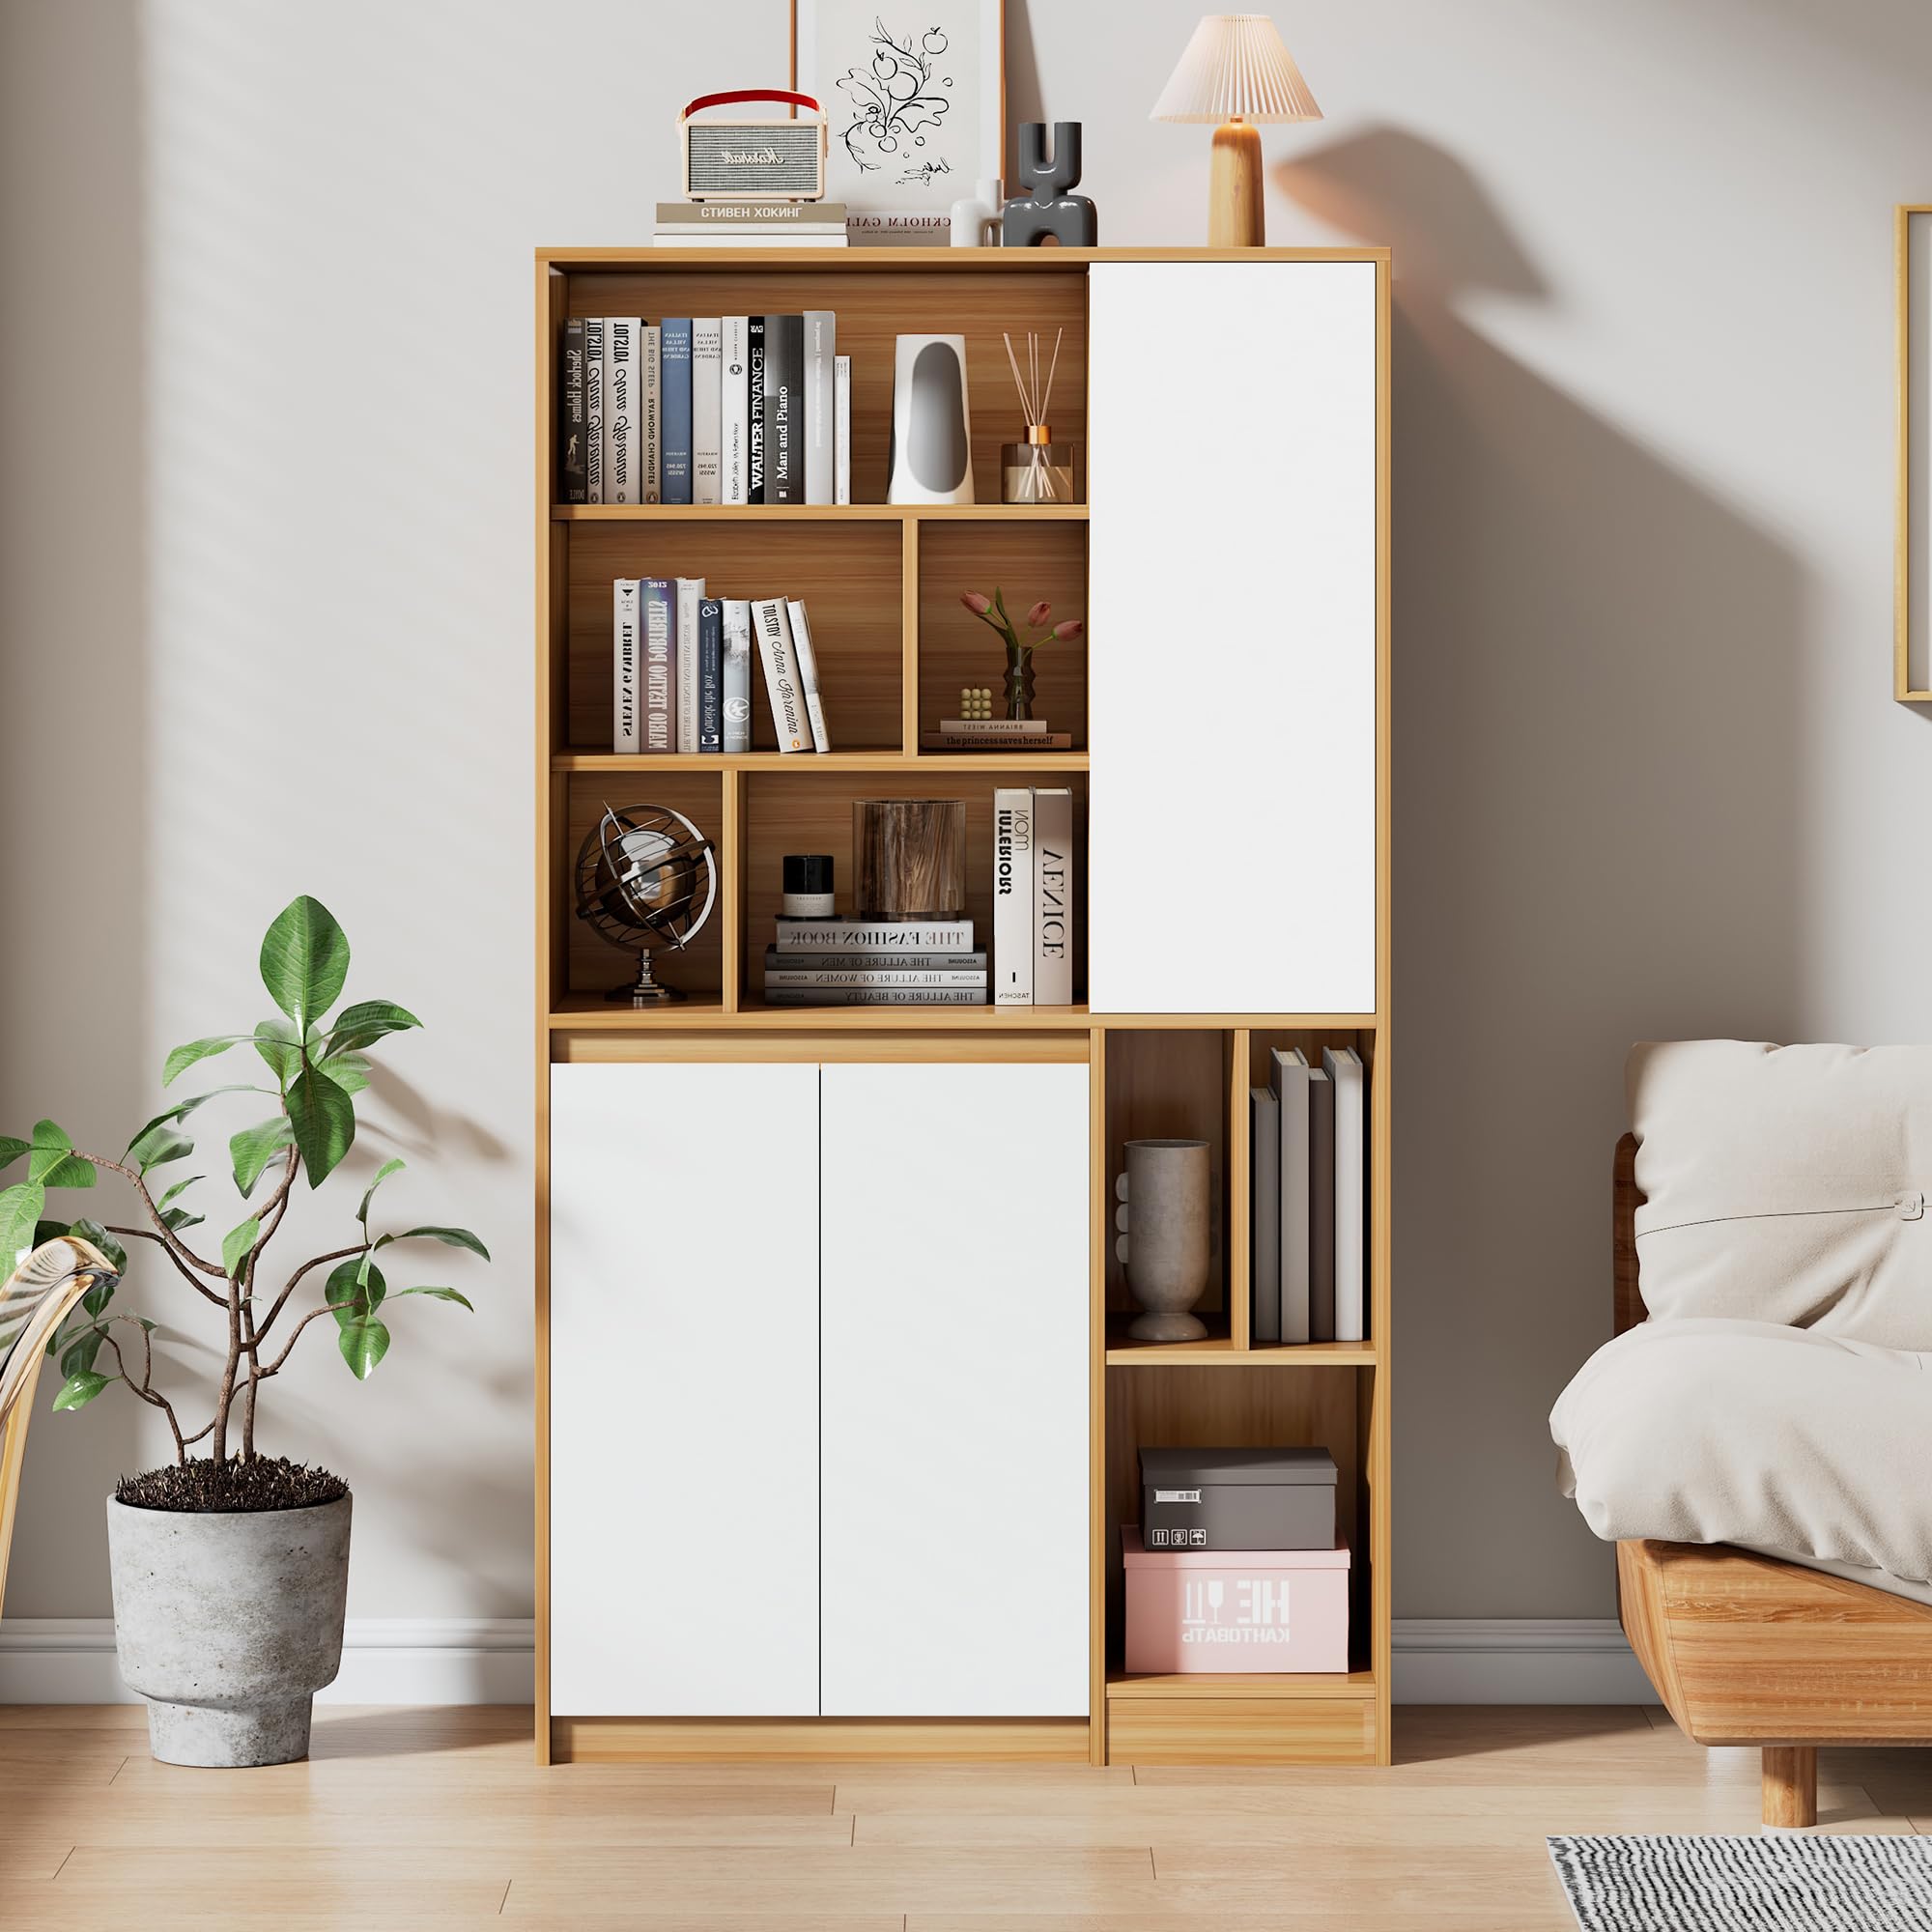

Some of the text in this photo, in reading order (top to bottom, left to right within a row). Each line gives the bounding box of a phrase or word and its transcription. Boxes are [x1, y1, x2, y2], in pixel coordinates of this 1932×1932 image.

[701, 207, 803, 218] СТИВЕН ХОКИНГ
[752, 348, 763, 490] WALTER FINANCE
[776, 386, 788, 480] Man and Piano
[762, 604, 798, 734] TOLSTOY Anna Karenina
